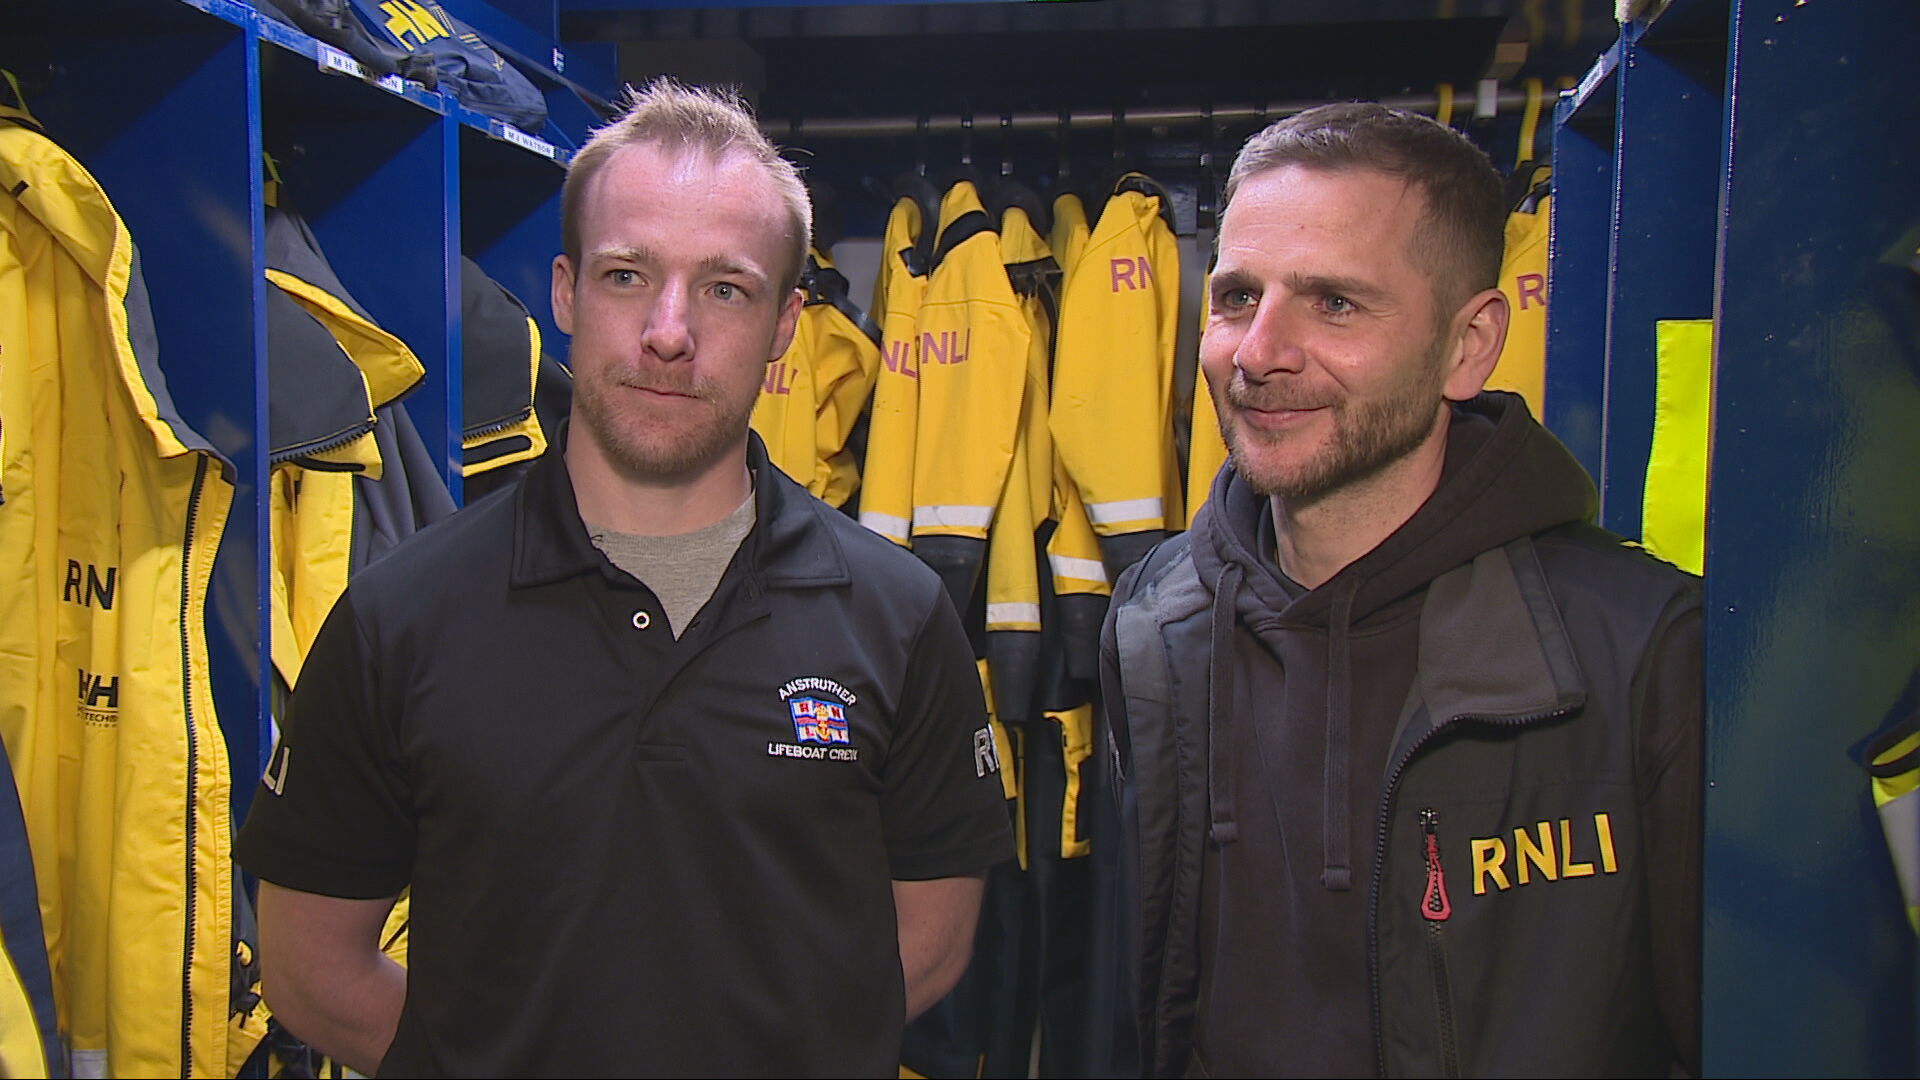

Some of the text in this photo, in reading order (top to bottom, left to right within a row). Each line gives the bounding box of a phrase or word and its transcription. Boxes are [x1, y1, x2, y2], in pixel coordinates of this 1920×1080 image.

[1516, 274, 1545, 310] R
[64, 559, 117, 610] RN
[778, 677, 857, 706] ANSTRUTHER
[768, 743, 858, 761] LIFEBOAT CREW
[974, 723, 999, 777] R
[1471, 813, 1618, 895] RNLI
